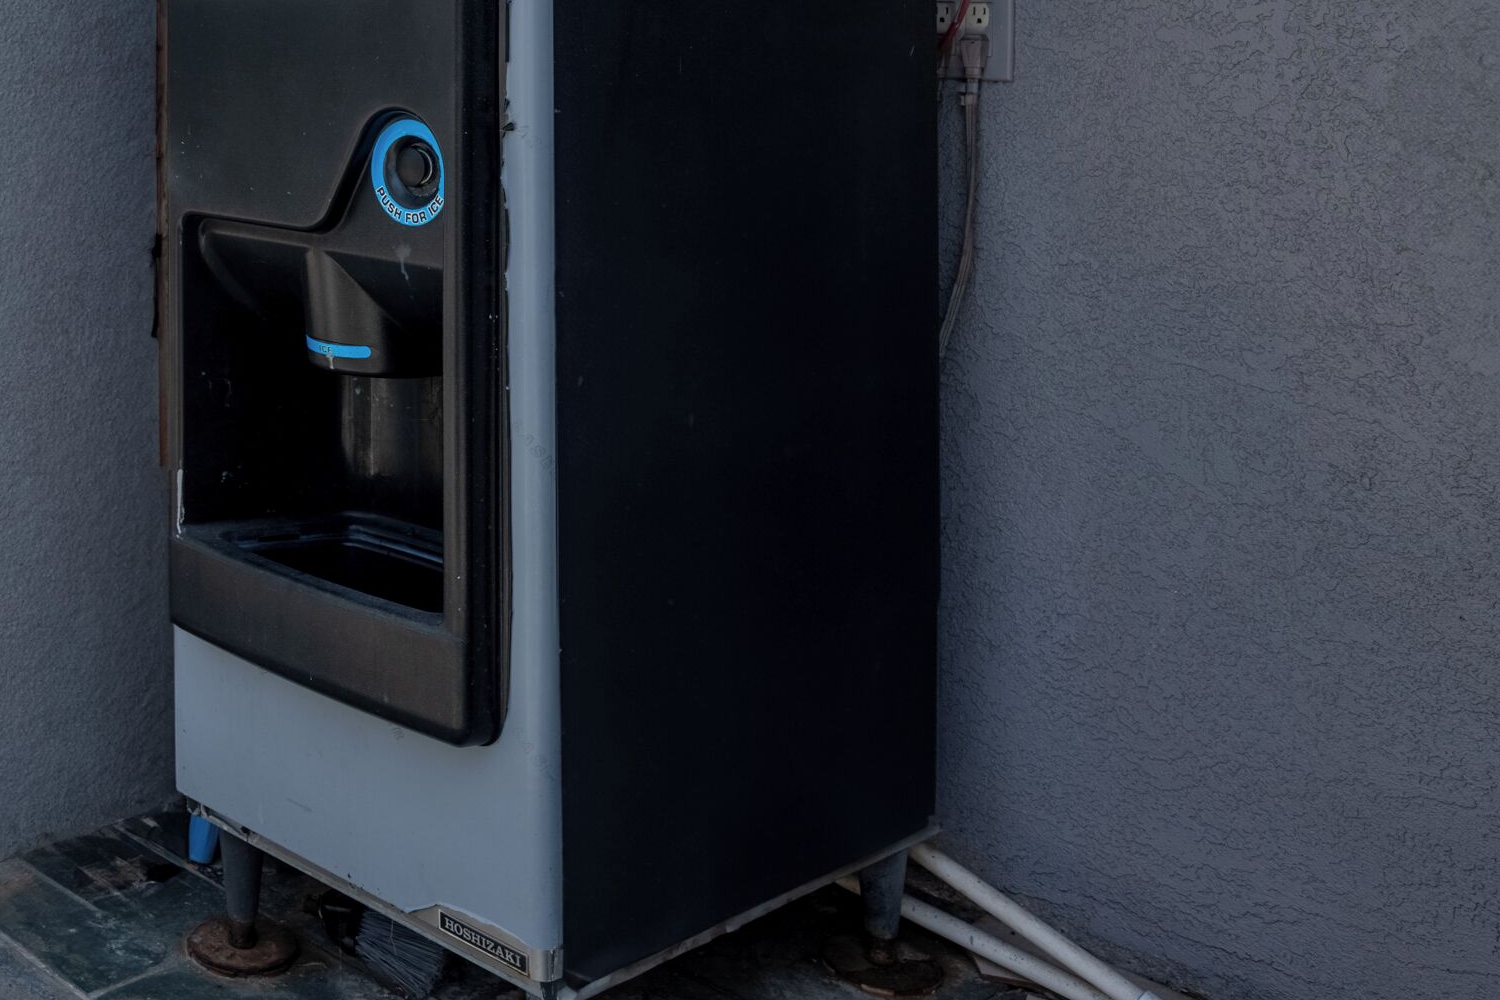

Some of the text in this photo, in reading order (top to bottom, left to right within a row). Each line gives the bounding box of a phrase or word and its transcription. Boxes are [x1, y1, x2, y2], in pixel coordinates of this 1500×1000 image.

[376, 185, 444, 224] PUSH FOR ICE
[444, 917, 522, 968] HOSHIZAKI
